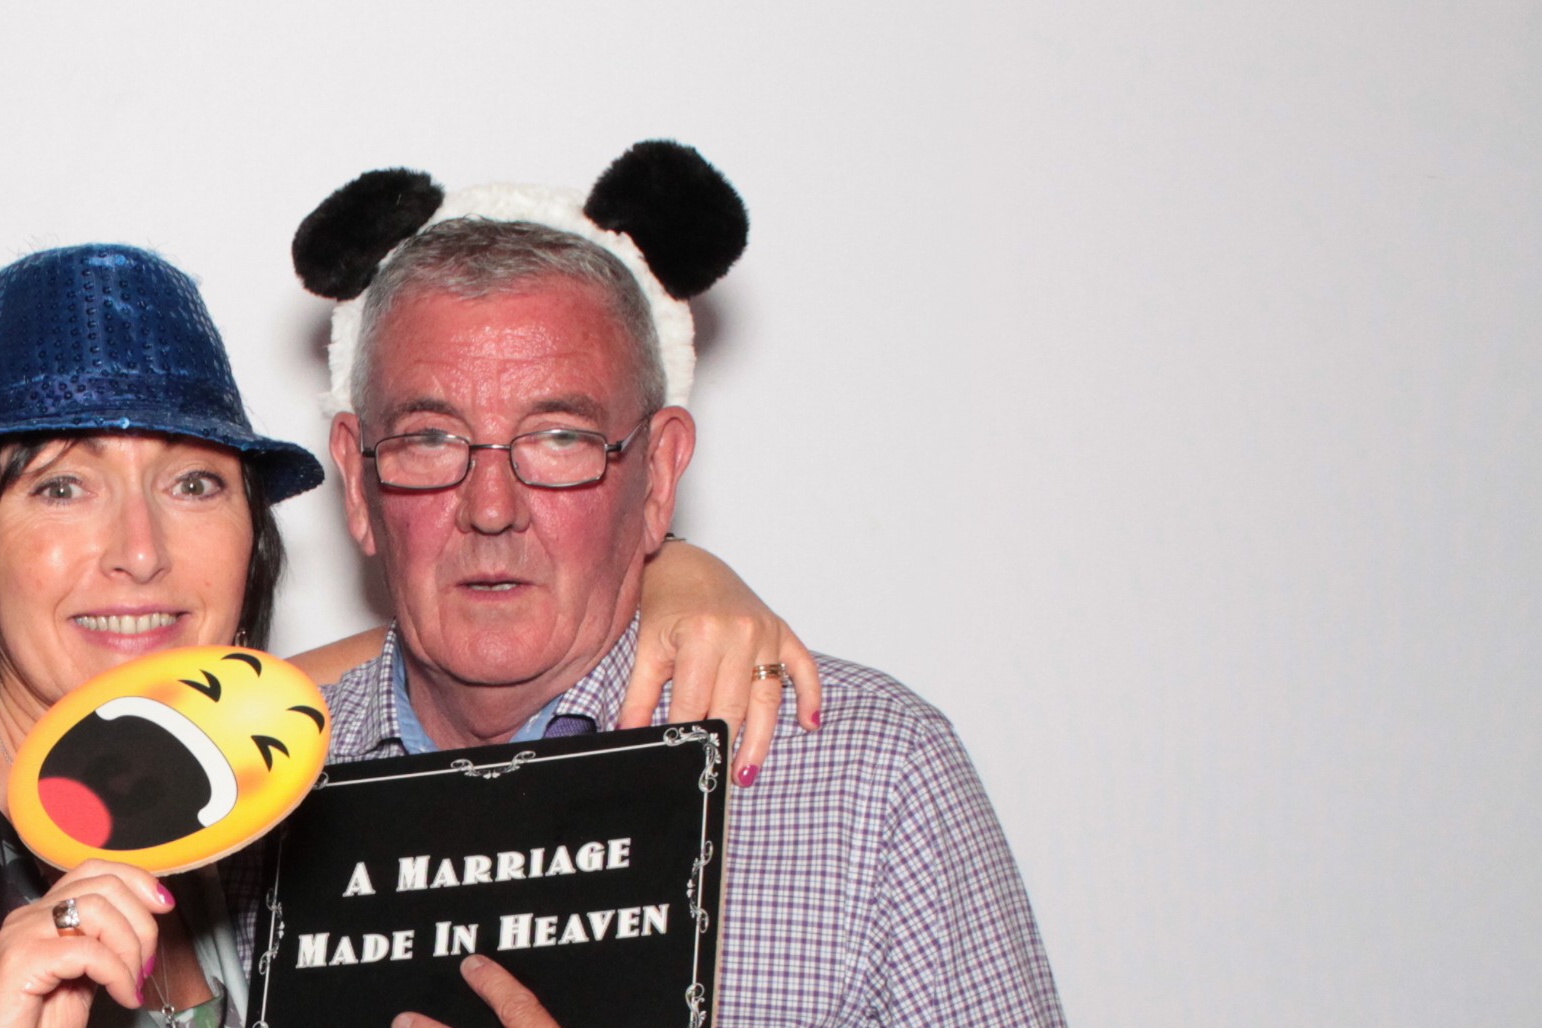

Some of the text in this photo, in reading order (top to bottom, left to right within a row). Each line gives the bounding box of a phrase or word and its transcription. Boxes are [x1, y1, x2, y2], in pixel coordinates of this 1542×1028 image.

[343, 837, 631, 897] A MARRIAGE
[295, 903, 670, 969] MADE IN HEAVEN
